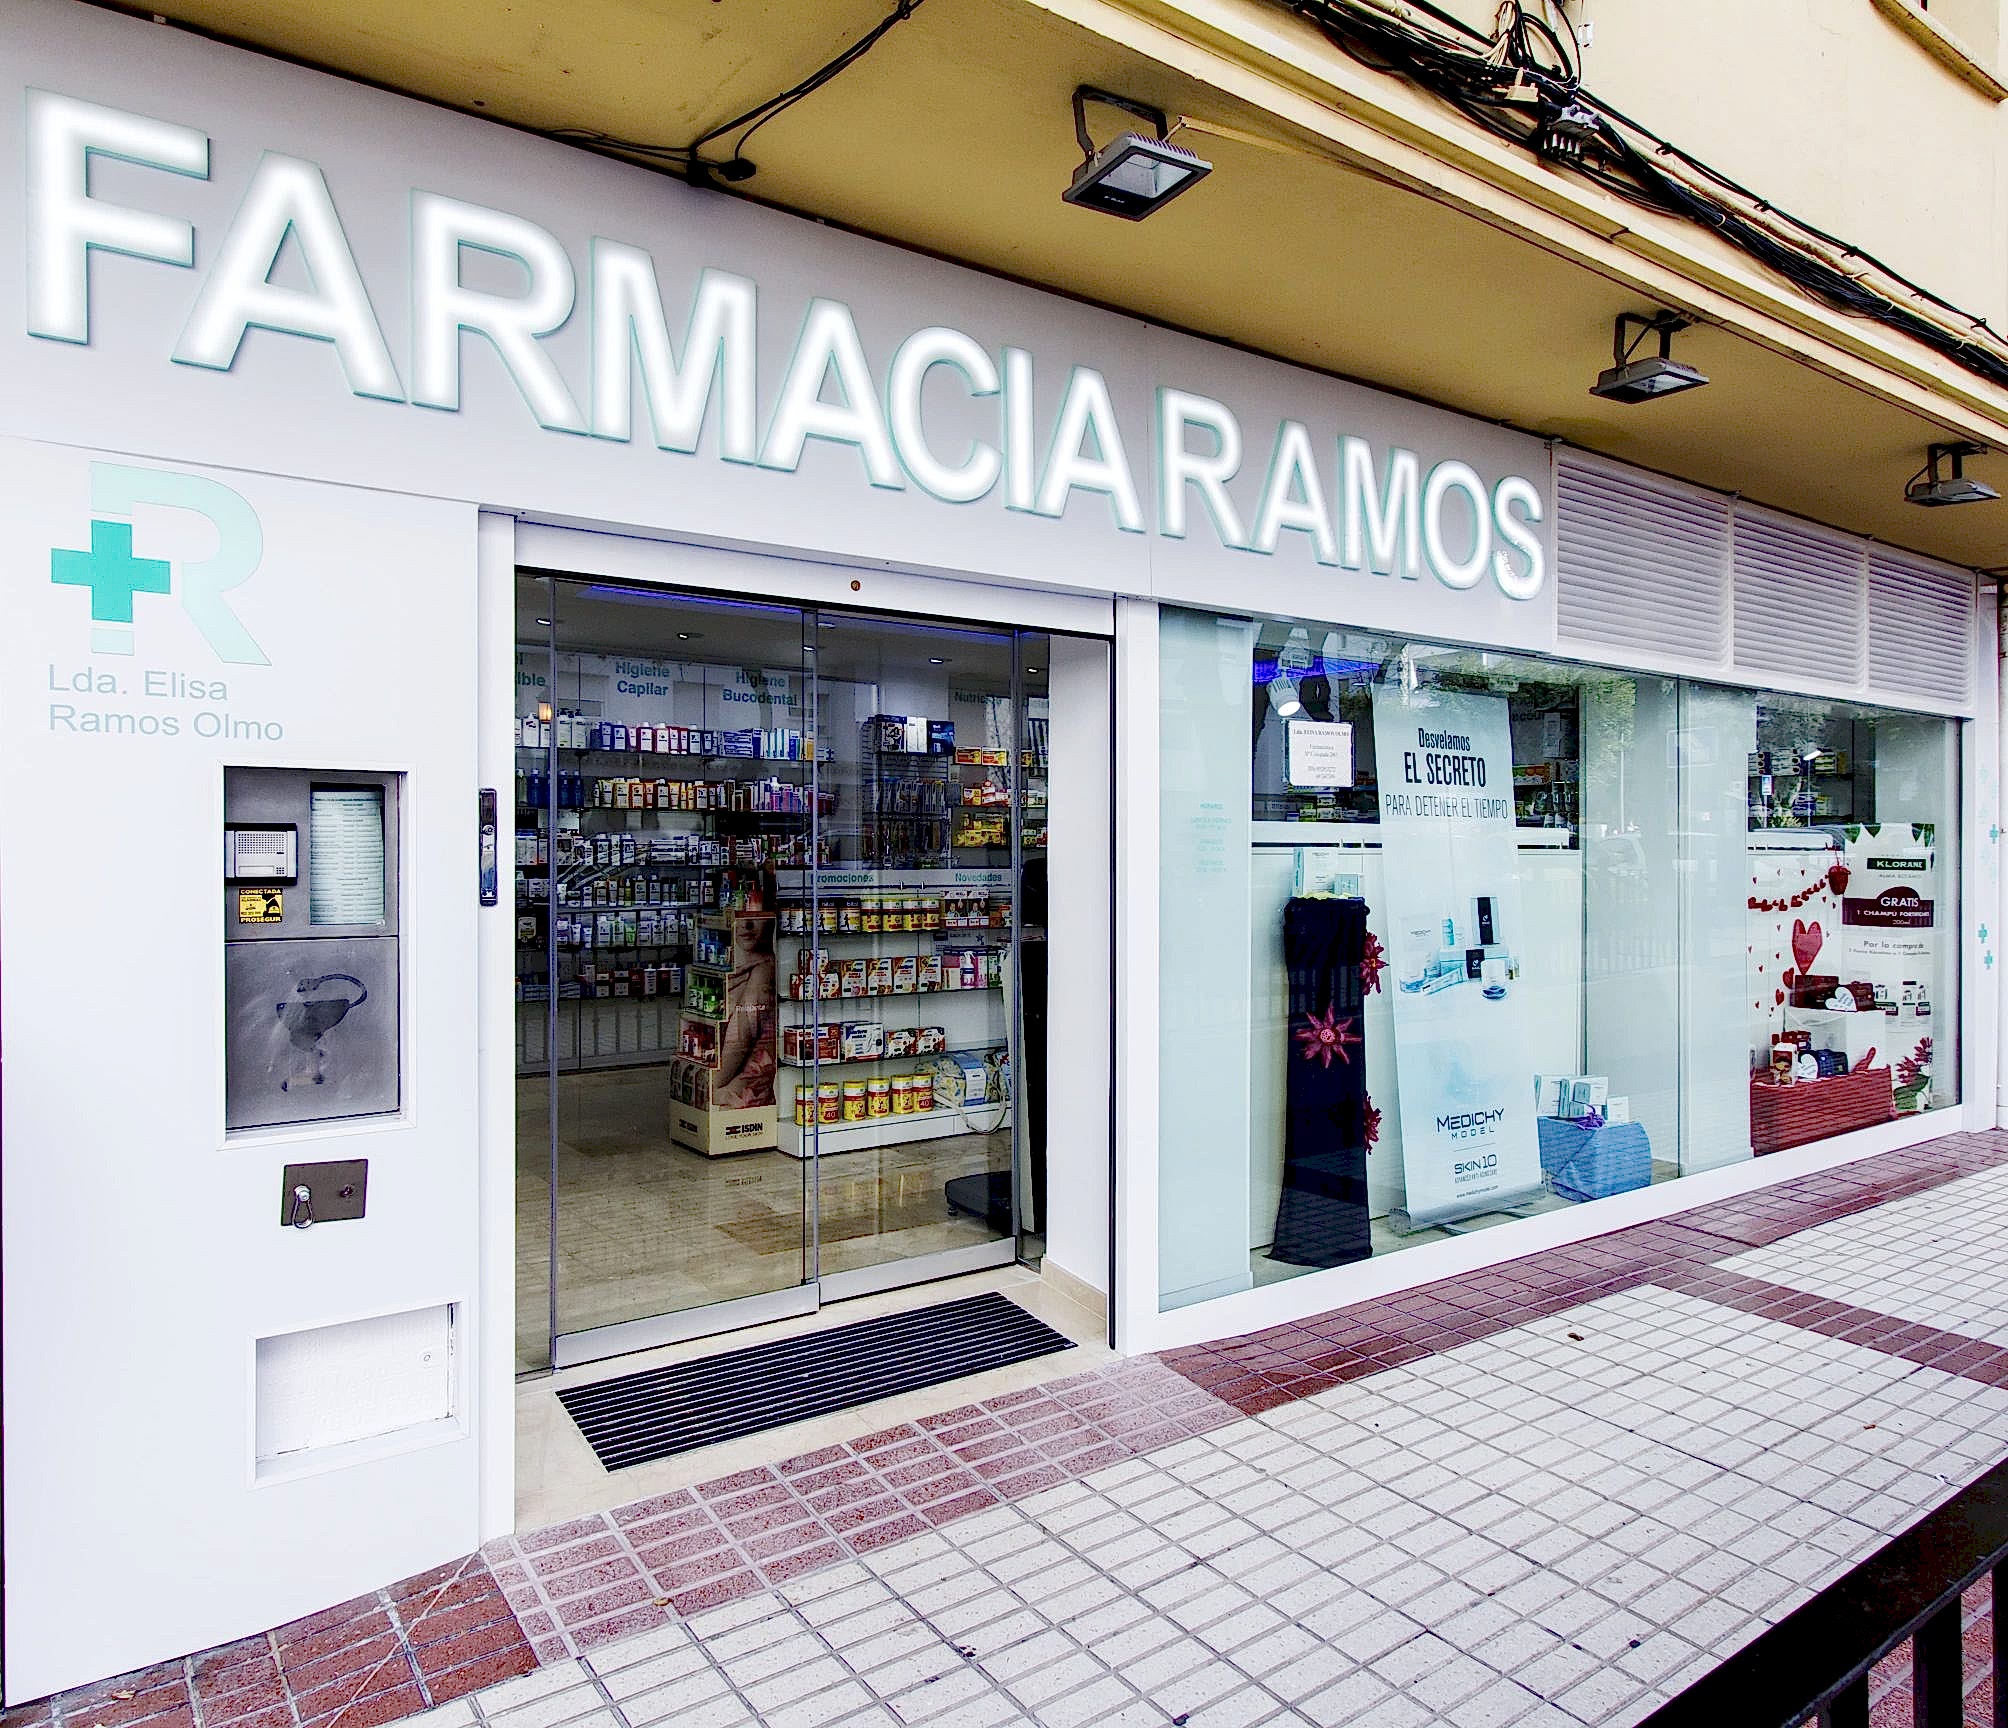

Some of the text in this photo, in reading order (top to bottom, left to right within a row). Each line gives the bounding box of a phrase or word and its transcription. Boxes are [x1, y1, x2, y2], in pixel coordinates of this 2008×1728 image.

[25, 86, 1546, 600] FARMACIA RAMOS
[615, 661, 671, 679] Higiene
[48, 663, 228, 701] Lda. Elisa
[616, 680, 669, 697] Capilar
[722, 688, 798, 706] Bucodental
[48, 704, 284, 741] Ramos Olmo
[1417, 727, 1471, 751] Desvelamos
[1403, 751, 1487, 787] EL SECRETO
[1385, 794, 1508, 819] PARA DETENER EL TIEMPO
[1876, 860, 1923, 868] KLORANE
[954, 872, 1003, 883] Novedades
[1880, 896, 1919, 907] GRATIS
[741, 1122, 764, 1134] ISDIN
[1436, 1108, 1505, 1133] MEDICHY
[1451, 1126, 1496, 1140] MODEL
